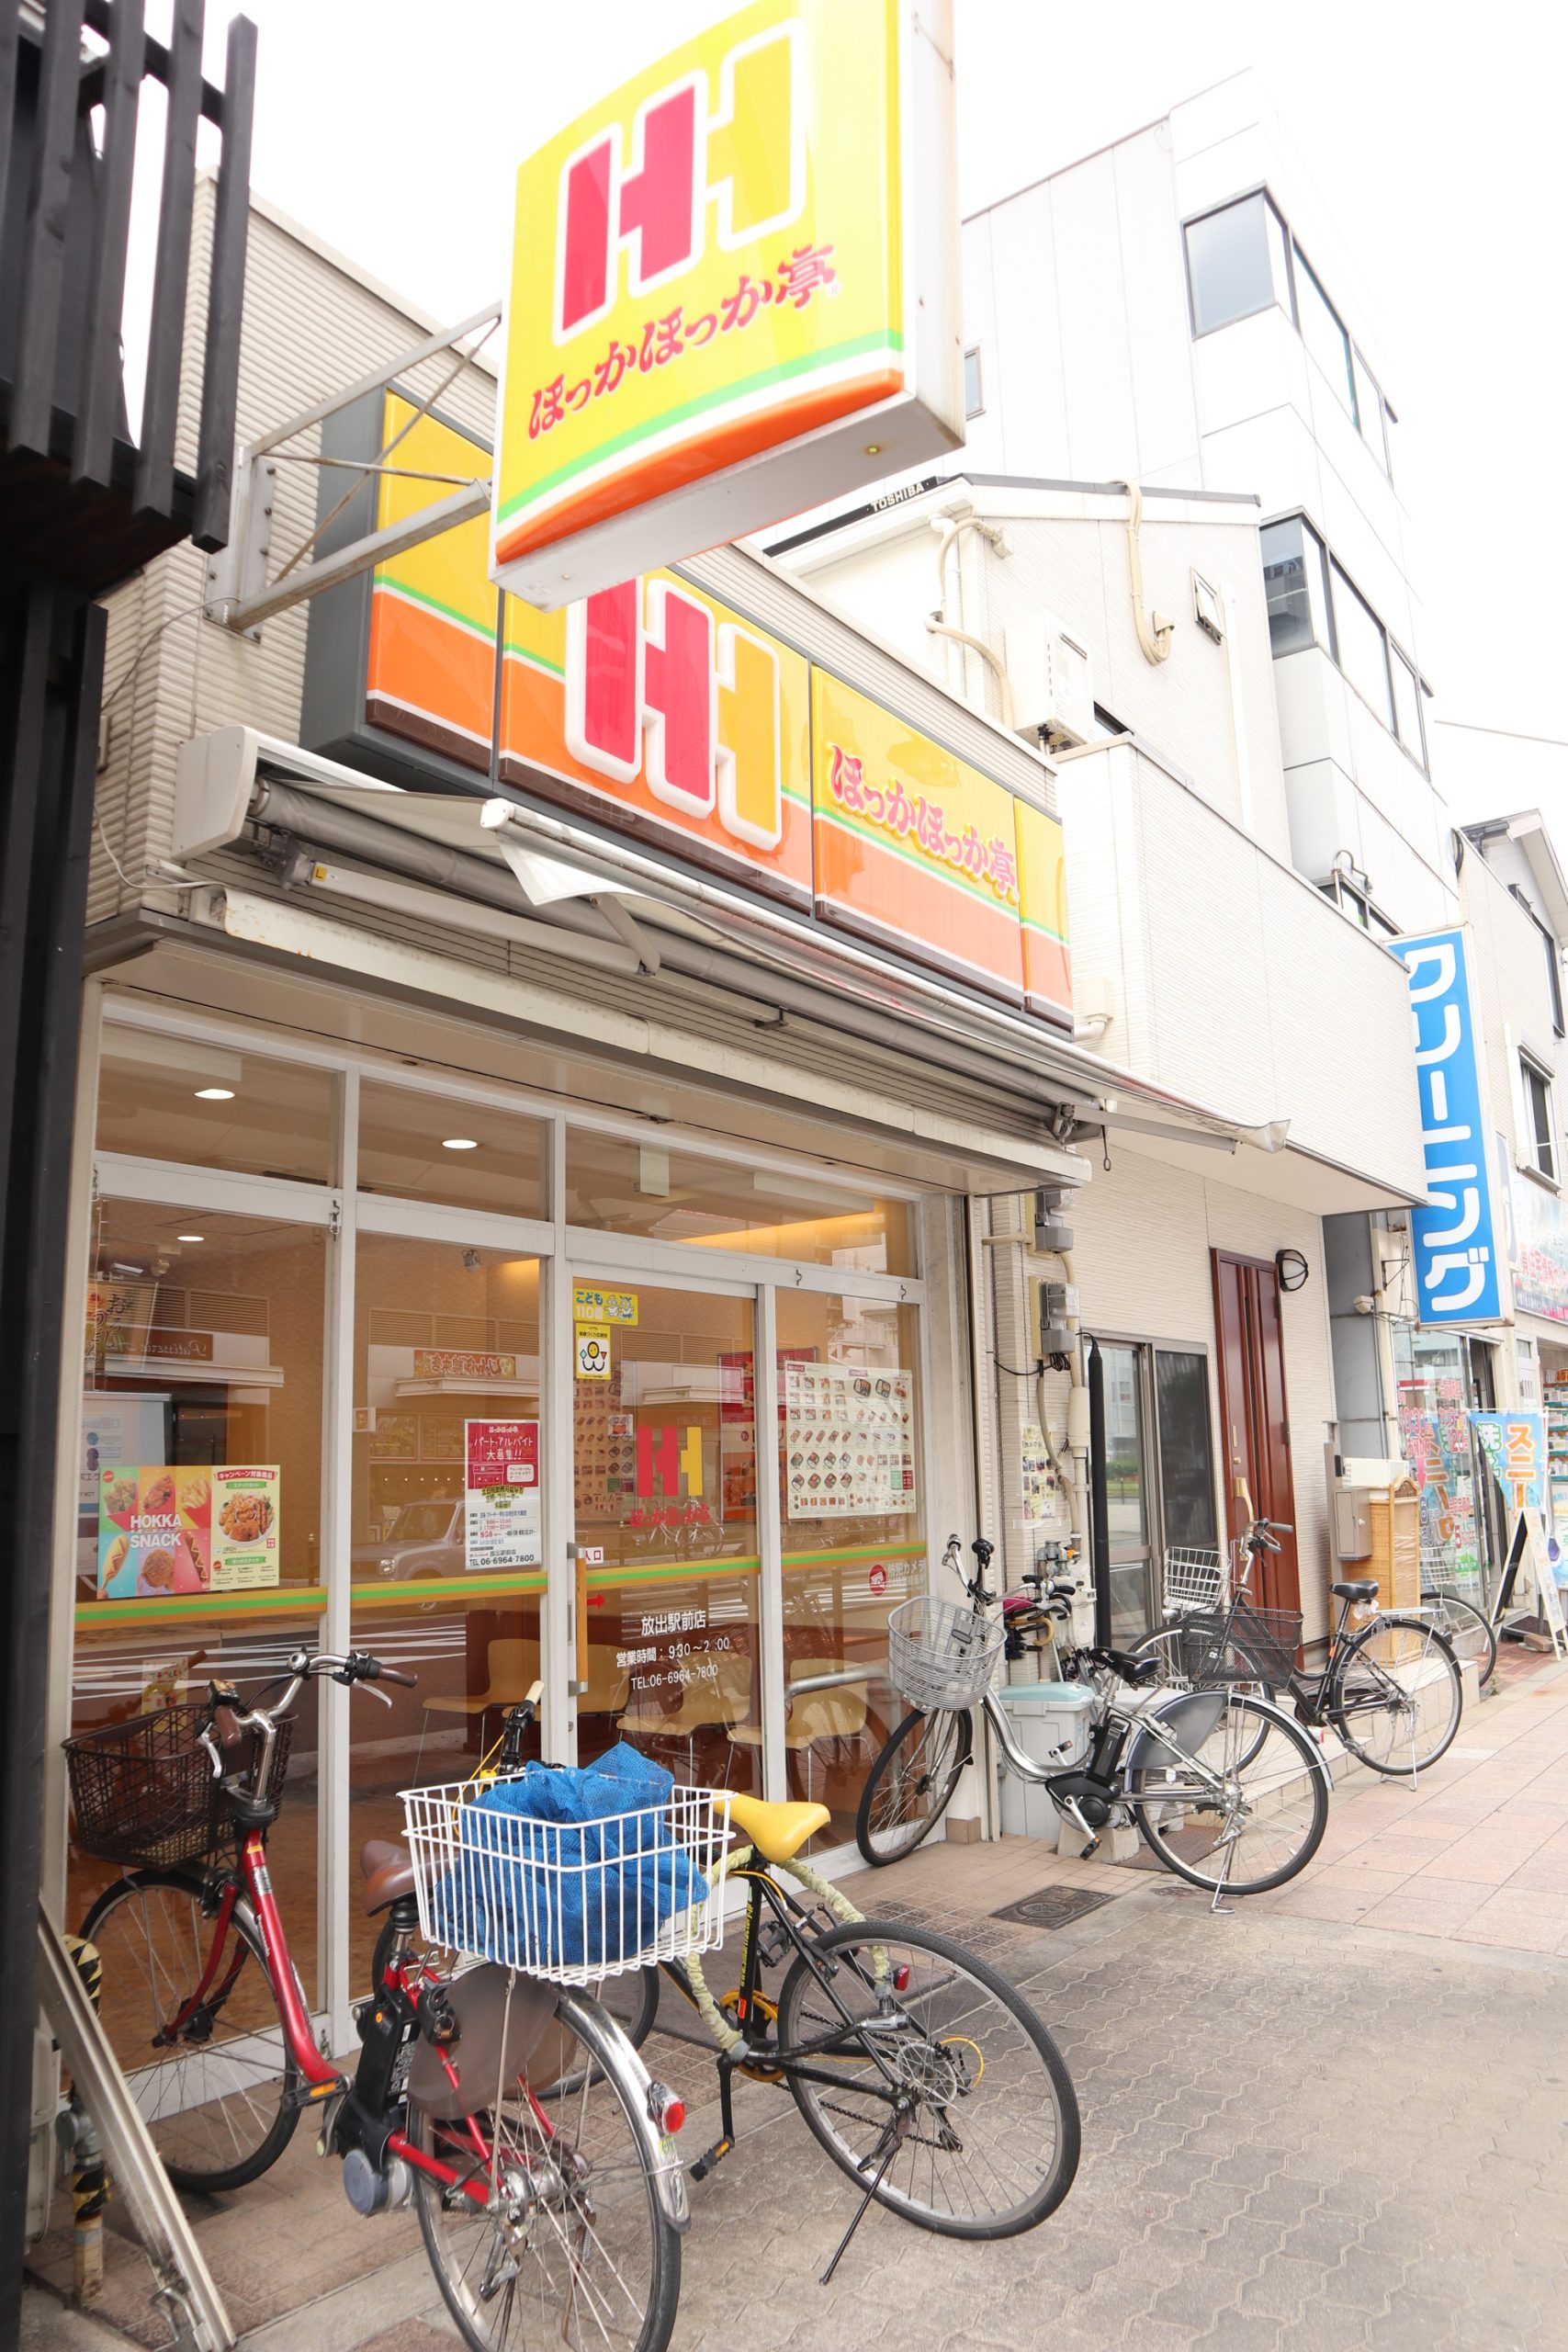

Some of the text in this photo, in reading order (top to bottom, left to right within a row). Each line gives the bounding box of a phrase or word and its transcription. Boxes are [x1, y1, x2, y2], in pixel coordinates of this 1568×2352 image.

[528, 244, 835, 439] ほっかほっか亭
[871, 483, 925, 512] TOSHIBA
[830, 744, 1015, 893] ほっかほっか亭
[576, 1291, 604, 1306] こども
[474, 1436, 534, 1446] パート・アルバイト
[130, 1514, 182, 1529] HOKKA
[130, 1532, 182, 1548] SNACK
[641, 1610, 706, 1636] 放出駅前店
